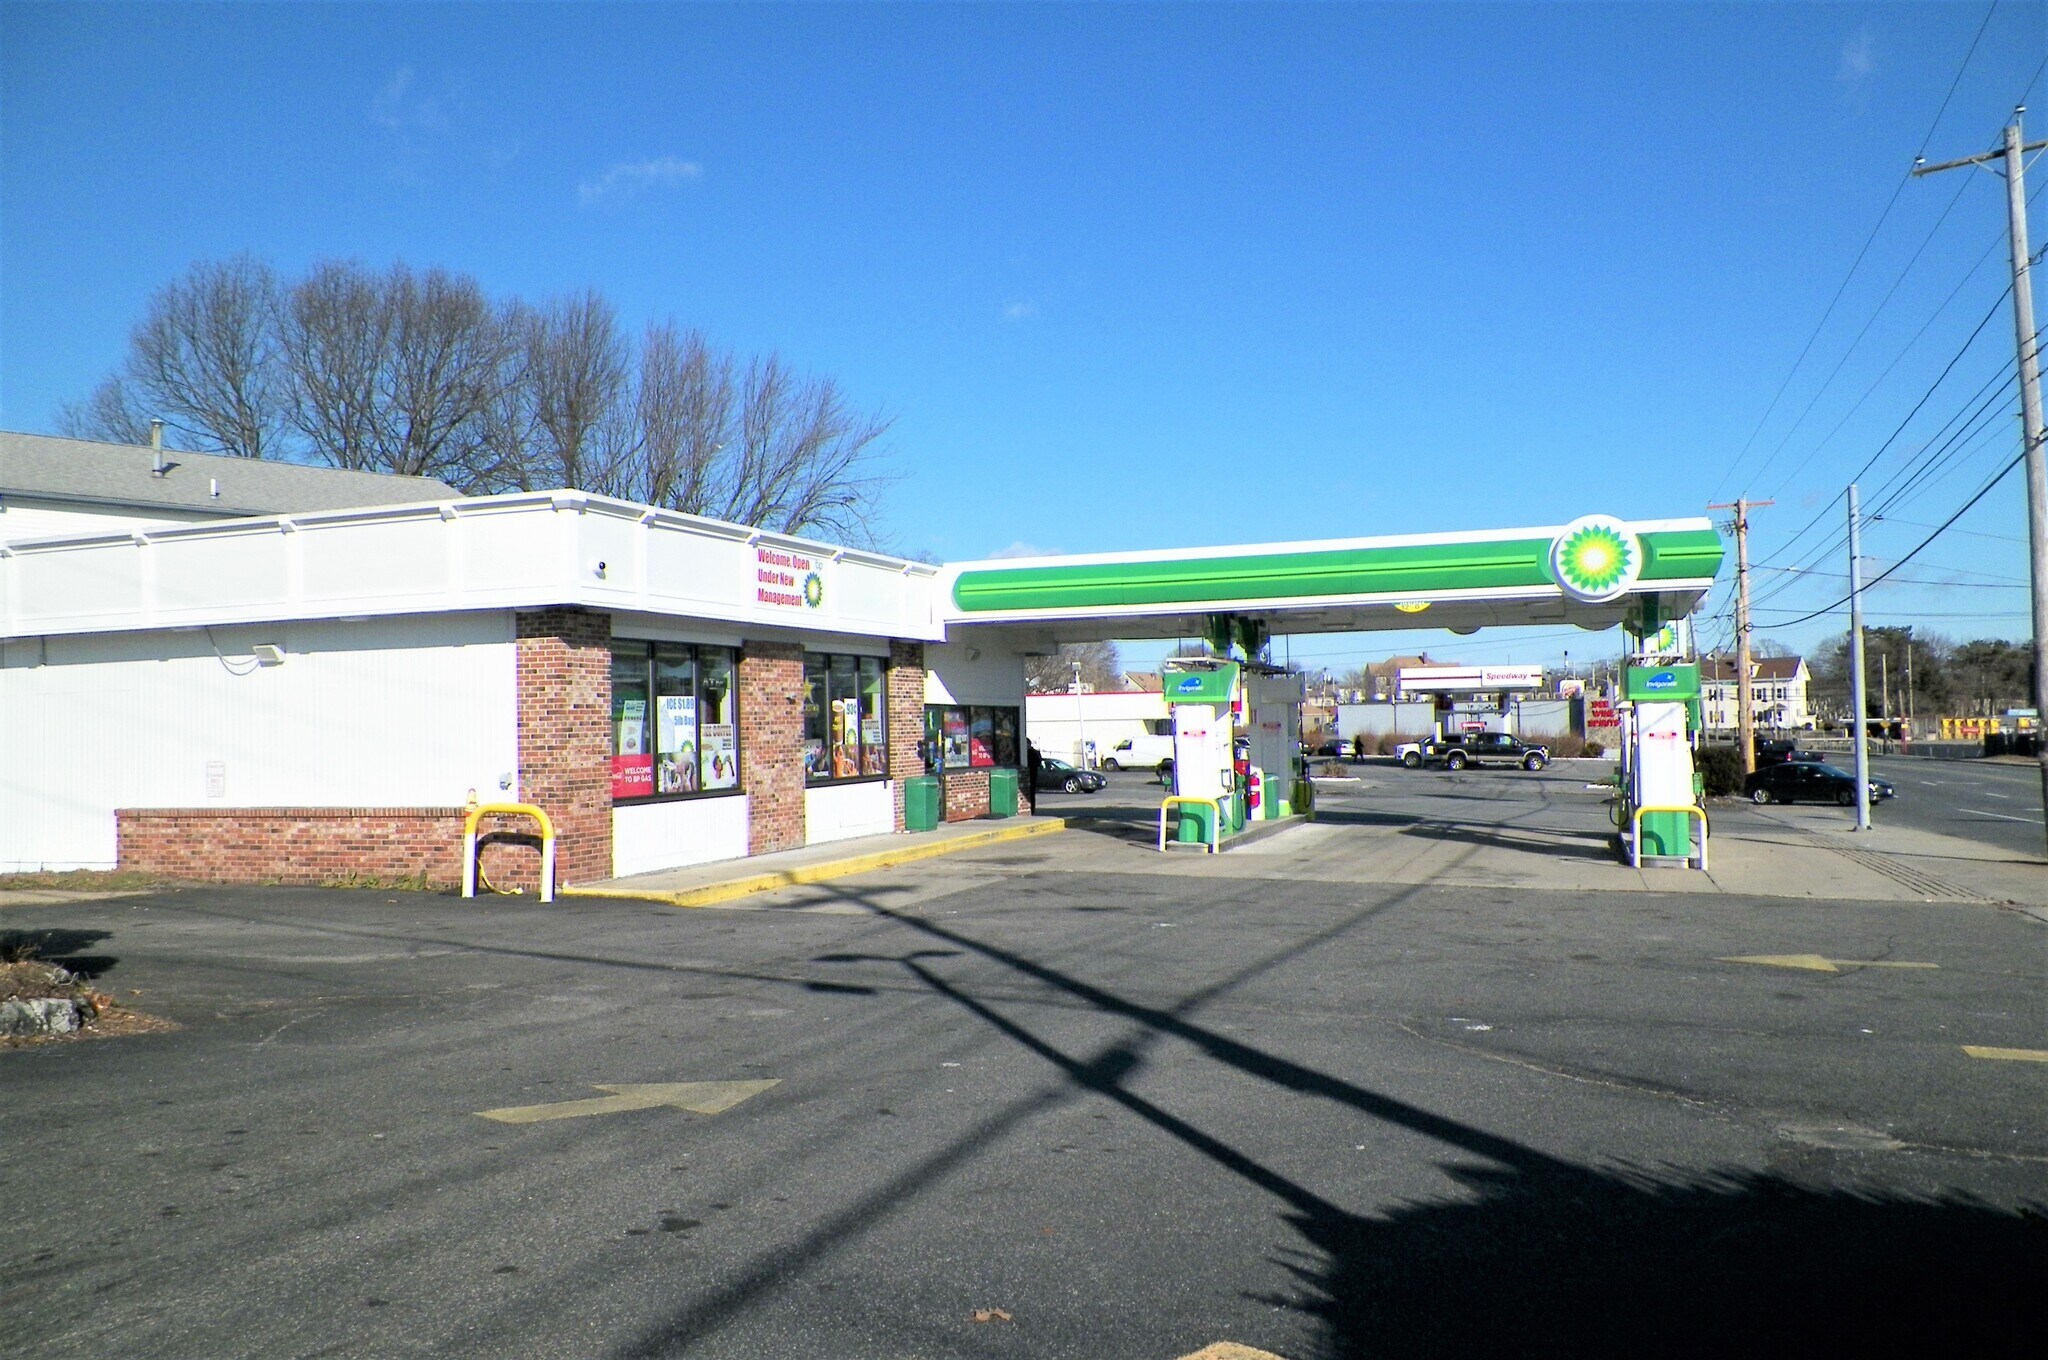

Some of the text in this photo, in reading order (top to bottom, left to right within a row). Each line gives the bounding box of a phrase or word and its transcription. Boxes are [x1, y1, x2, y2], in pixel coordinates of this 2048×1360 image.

[793, 554, 810, 571] Open
[758, 568, 794, 587] Under New
[758, 587, 802, 606] Management
[1486, 672, 1527, 681] Speedway
[1645, 680, 1677, 688] Invigorate
[667, 698, 677, 710] ICE
[684, 716, 695, 727] Bag
[624, 766, 652, 775] WELCOME
[625, 775, 633, 783] TO
[633, 775, 640, 783] BP
[640, 774, 652, 782] GAS
